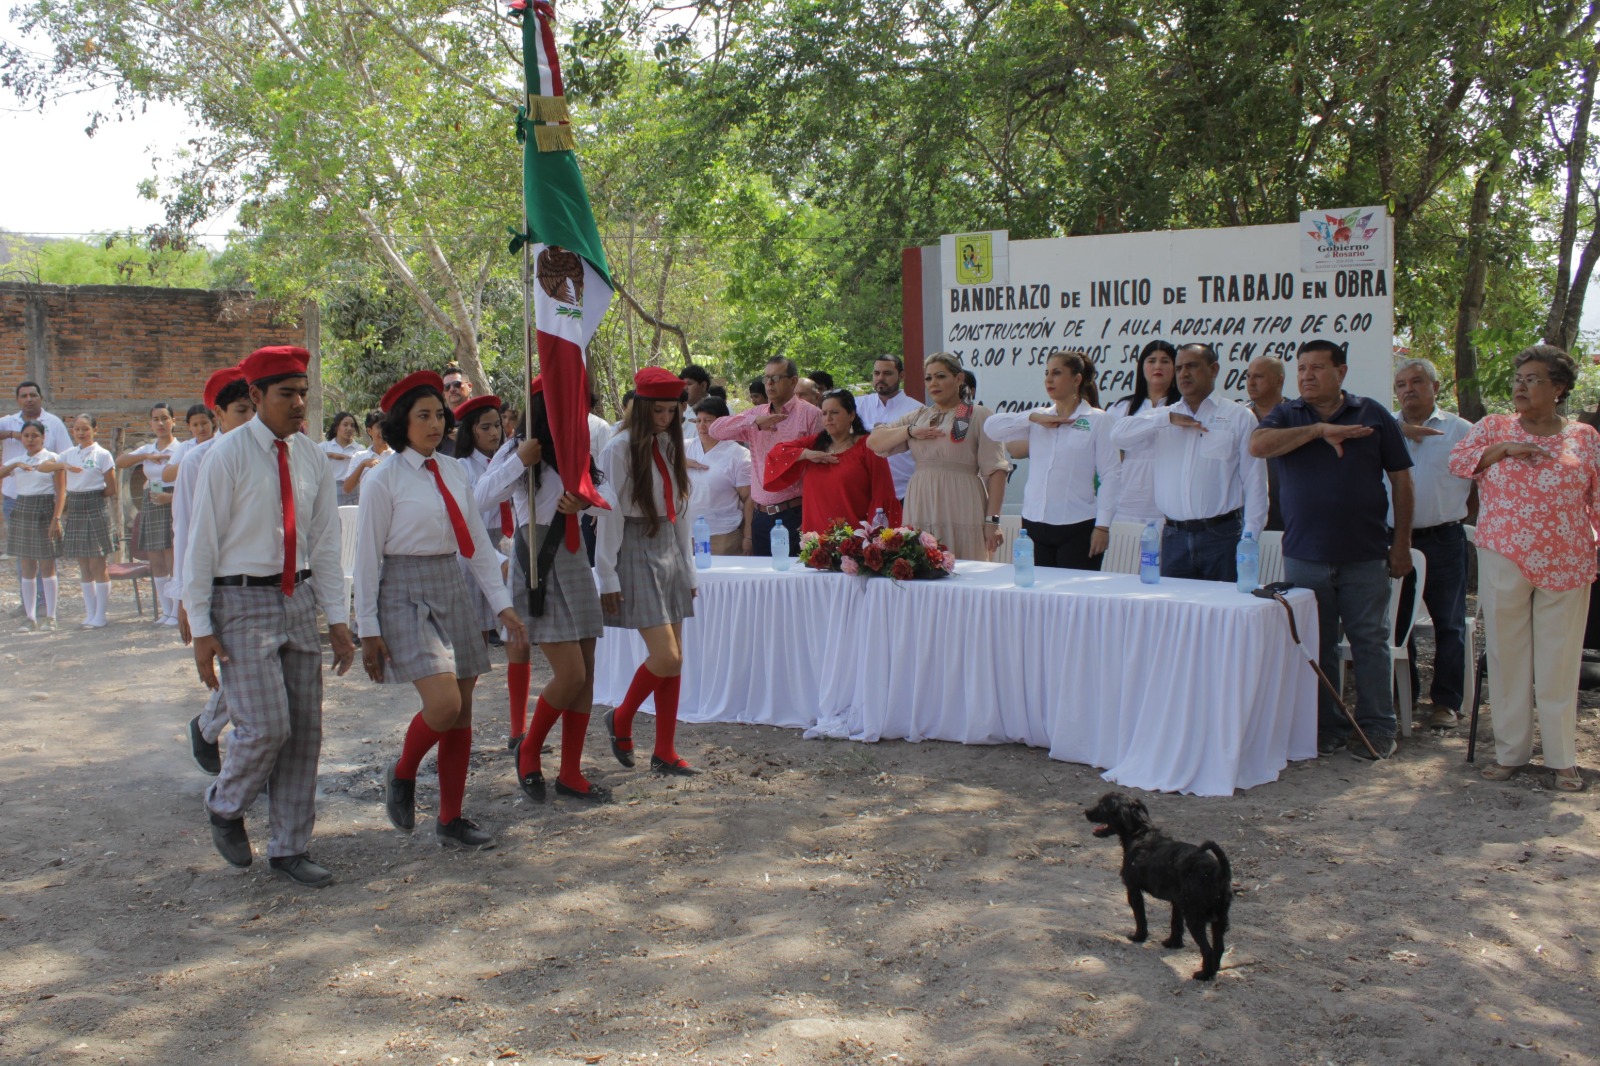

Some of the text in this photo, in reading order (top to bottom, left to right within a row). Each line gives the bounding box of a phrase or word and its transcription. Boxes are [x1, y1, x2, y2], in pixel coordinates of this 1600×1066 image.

[1317, 244, 1369, 252] Gobierno
[951, 270, 1387, 312] BANDERAZO DE INICIO DE TRABAJO EN OBRA
[949, 317, 1055, 342] CONSTRUCCIÓN
[1063, 319, 1085, 337] DE
[1118, 319, 1161, 336] AULA
[1171, 317, 1246, 336] ADOSADA
[1252, 316, 1292, 334] TIPO
[1300, 314, 1327, 333] DE
[1334, 313, 1373, 333] 6.00
[971, 348, 1005, 367] 8.00
[1012, 347, 1022, 366] Y
[1229, 342, 1257, 362] EN
